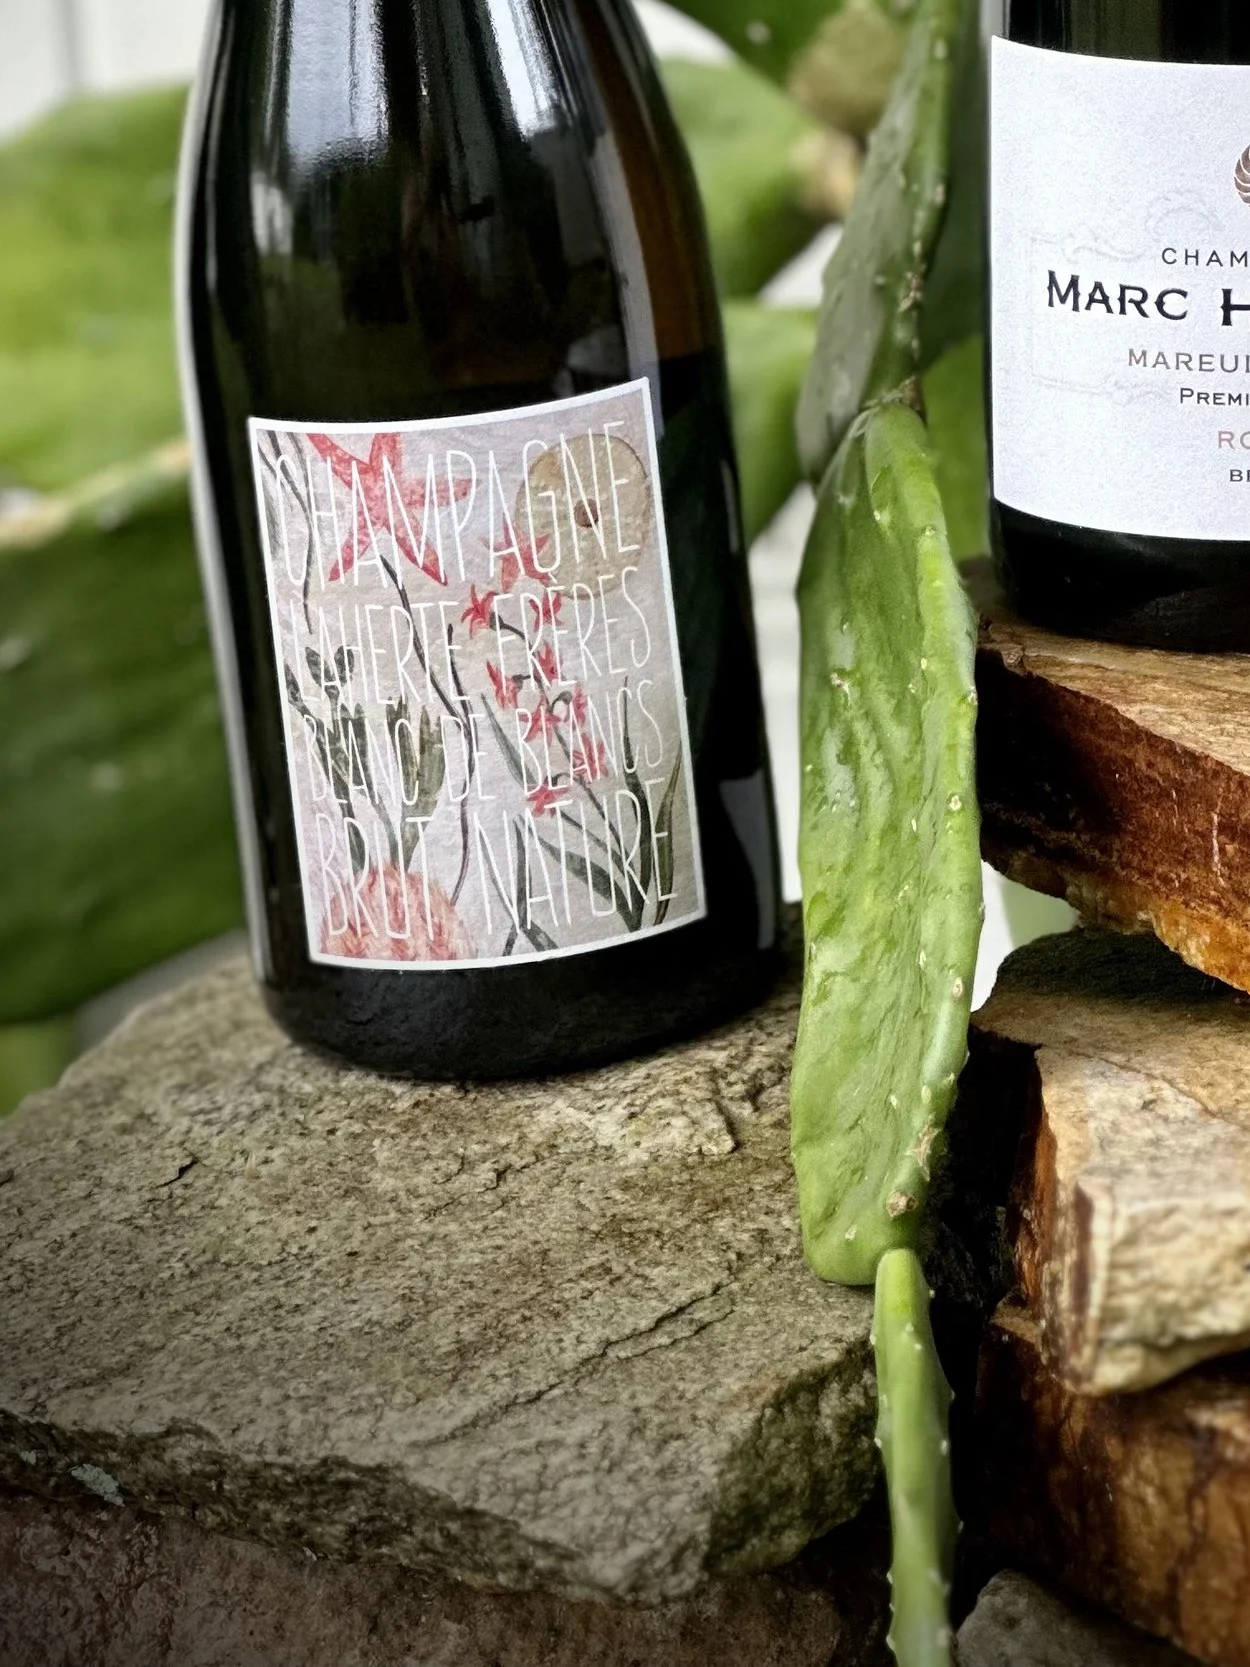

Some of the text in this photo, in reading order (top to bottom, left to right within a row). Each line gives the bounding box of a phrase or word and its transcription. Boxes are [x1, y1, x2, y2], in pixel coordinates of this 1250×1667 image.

[1046, 270, 1188, 321] MARC
[273, 420, 641, 590] CHAMPAGNE
[289, 565, 654, 708] LAHERTE FRÈRES
[300, 677, 666, 806] BLANC DE BLANCS
[313, 776, 679, 941] BRUT NATURE
